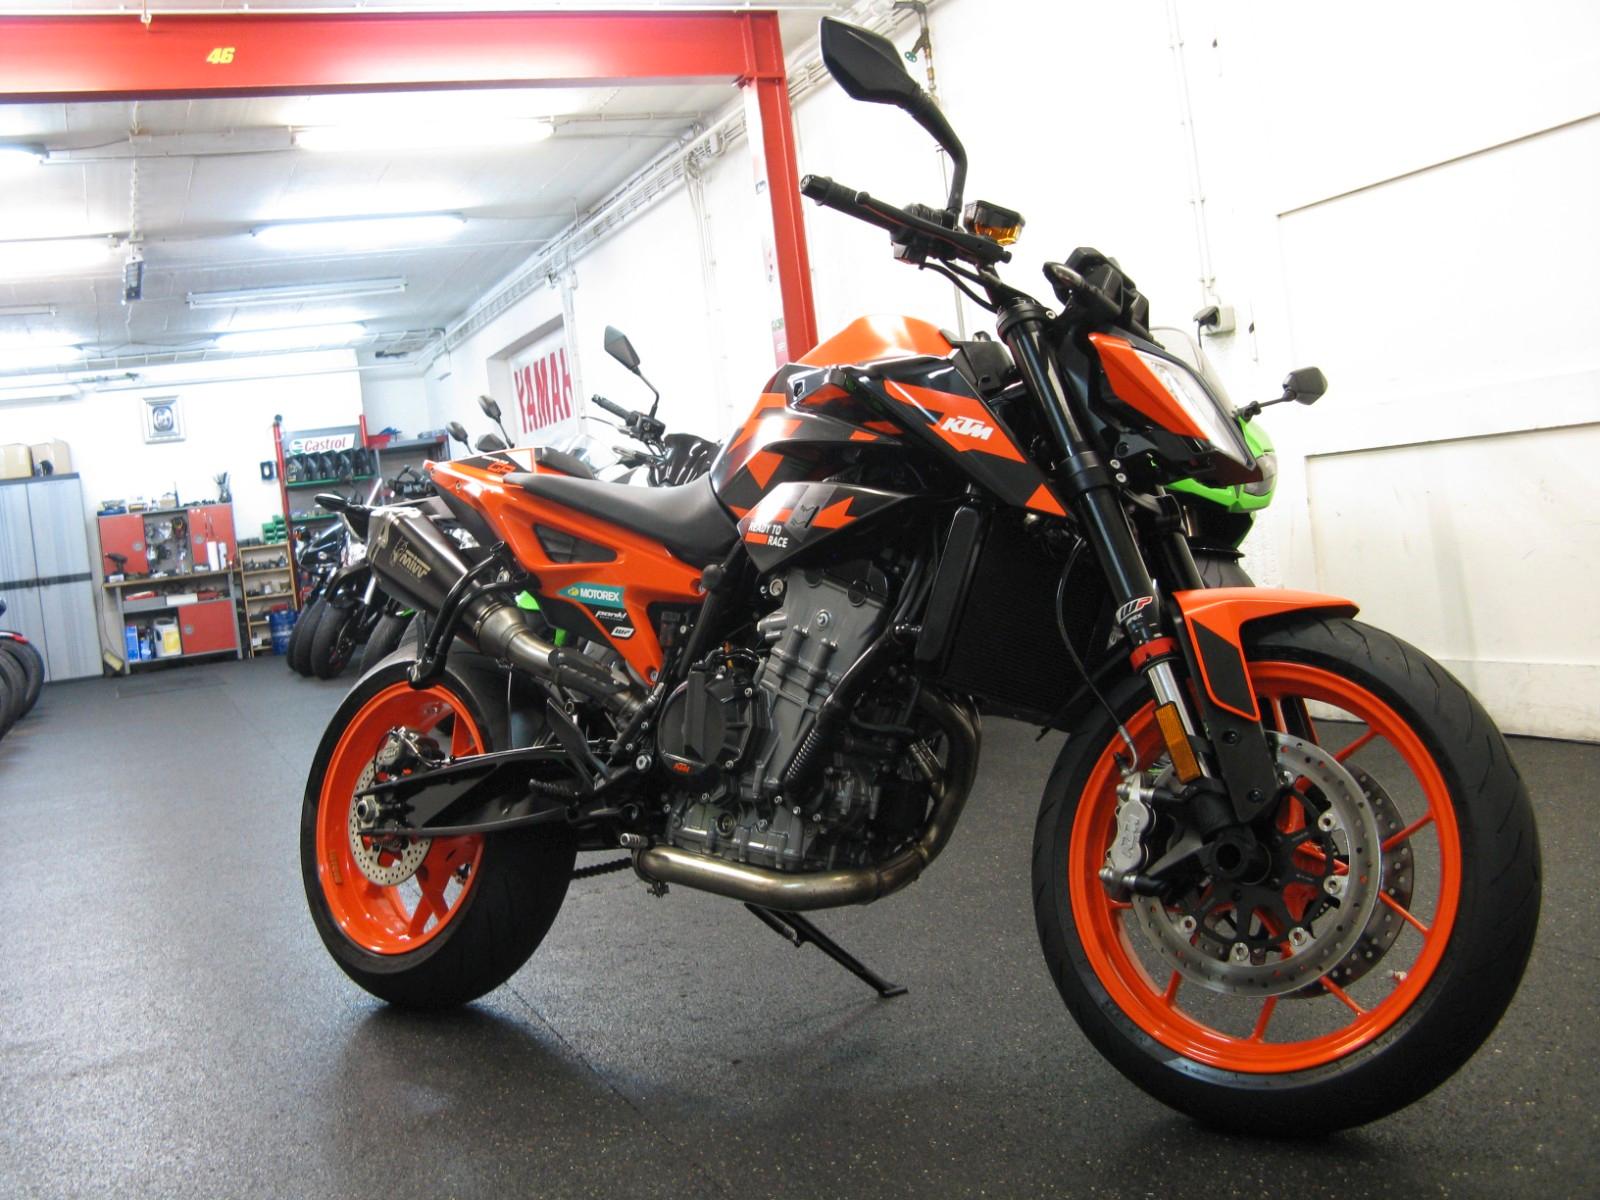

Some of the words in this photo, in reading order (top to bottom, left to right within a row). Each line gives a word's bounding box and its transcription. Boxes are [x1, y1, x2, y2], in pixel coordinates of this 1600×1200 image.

[207, 48, 235, 64] 46
[941, 416, 993, 440] KTM
[304, 436, 347, 453] Castrol
[748, 521, 770, 535] READY
[771, 524, 783, 536] TO
[767, 535, 789, 548] RACE
[580, 588, 619, 601] MOTOREX
[1115, 596, 1153, 624] WP
